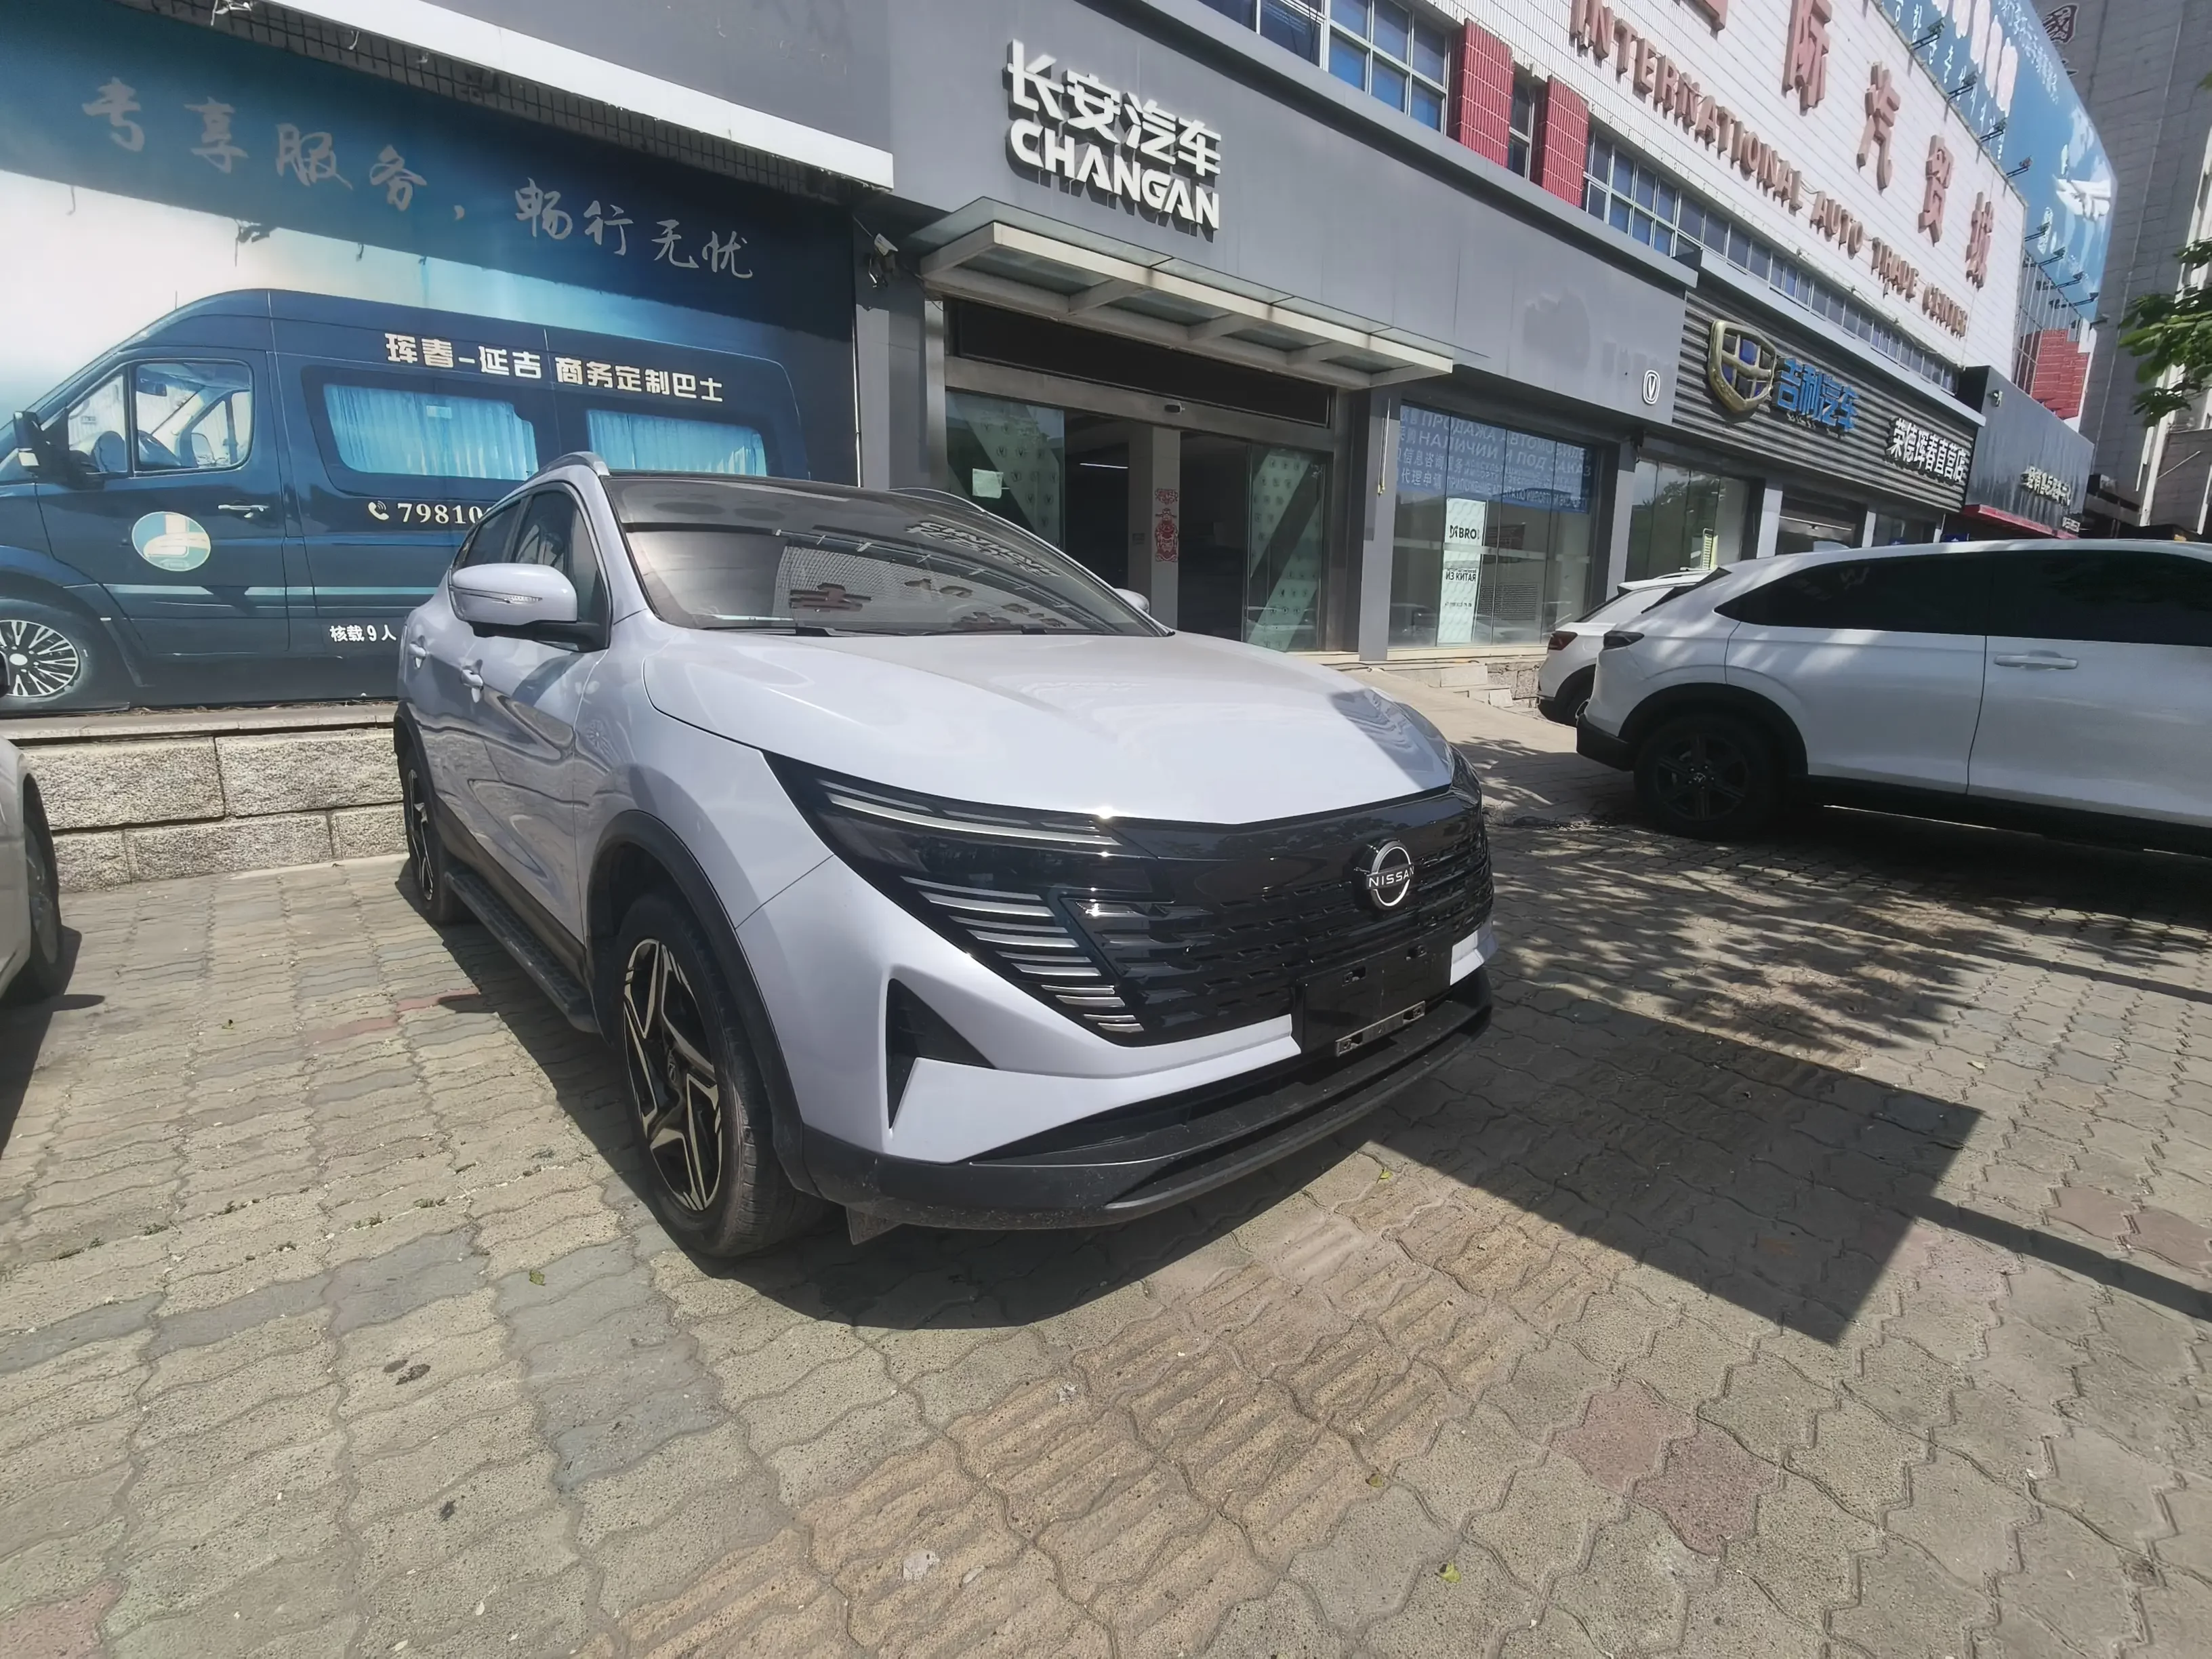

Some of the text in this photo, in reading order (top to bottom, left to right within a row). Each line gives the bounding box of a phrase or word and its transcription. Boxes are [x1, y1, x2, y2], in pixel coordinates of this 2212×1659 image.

[1006, 39, 1221, 178] 长安汽车
[1570, 0, 1803, 214] INTERNATIONAL
[1809, 190, 1864, 259] AUTO
[1009, 119, 1219, 231] CHANGAN
[556, 356, 724, 402] 商务定制巴士
[1778, 358, 1860, 432] 吉利汽车
[396, 503, 491, 525] 79810
[1446, 571, 1476, 583] ИЗ КИТАЯ
[1368, 866, 1415, 888] NISSAN
